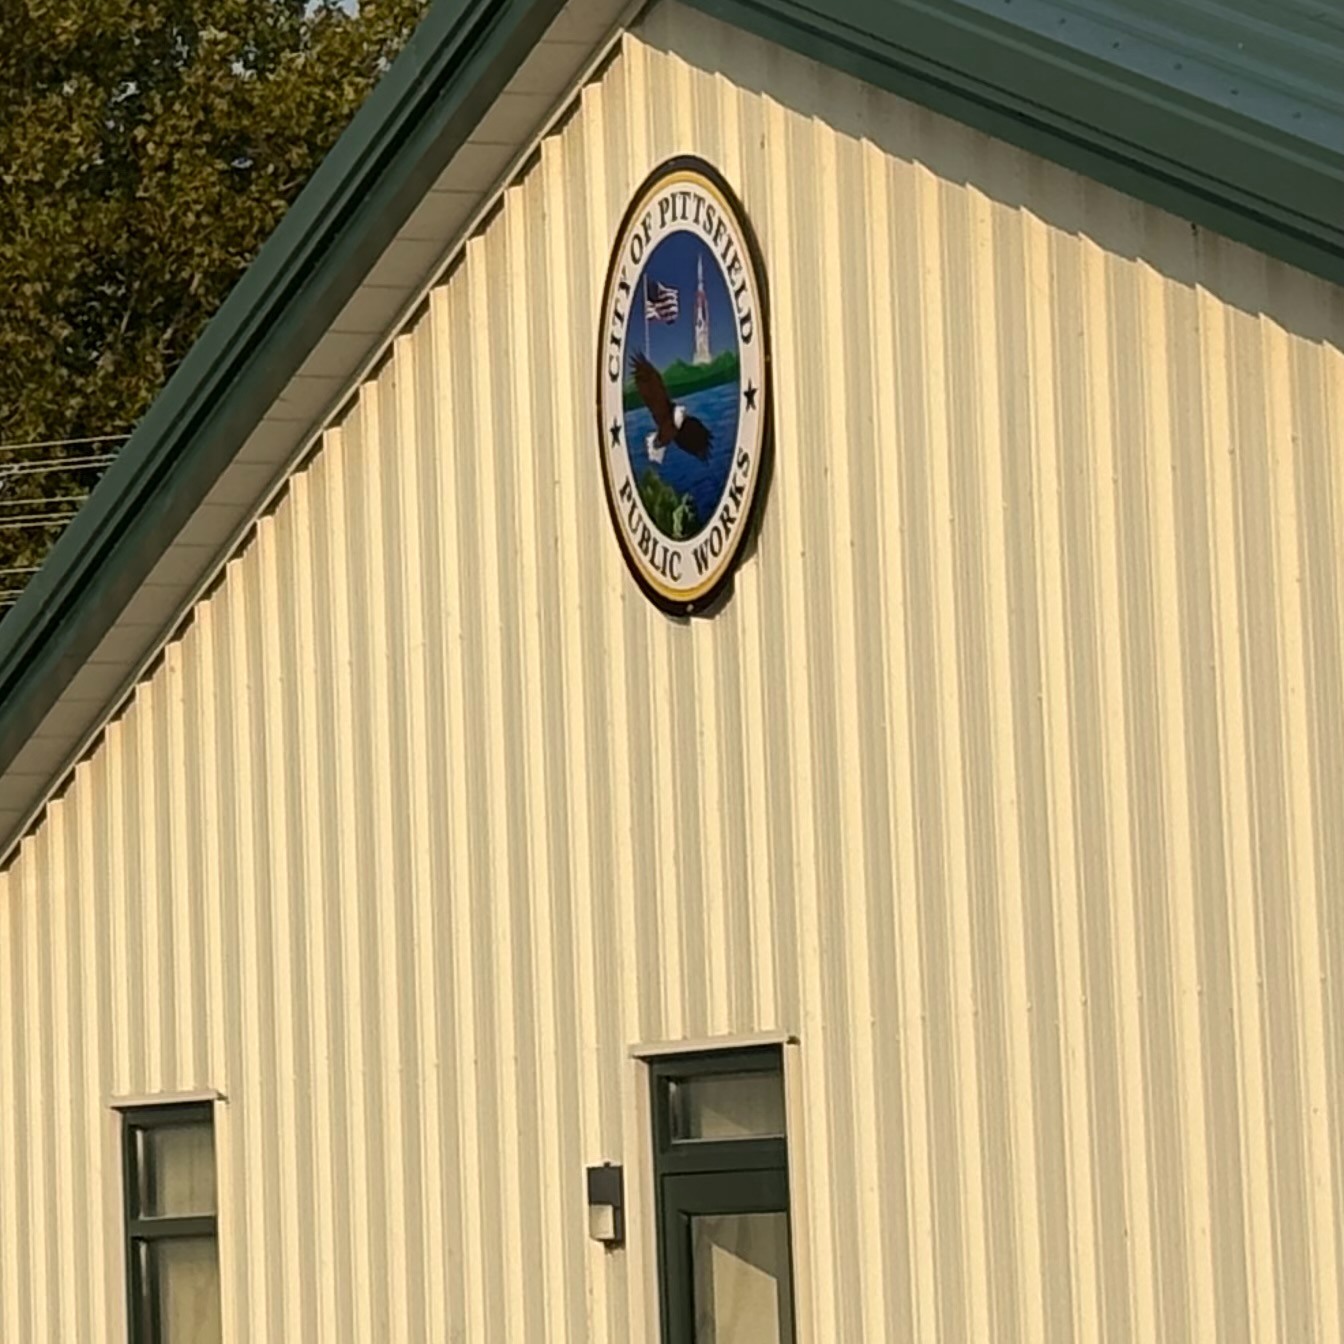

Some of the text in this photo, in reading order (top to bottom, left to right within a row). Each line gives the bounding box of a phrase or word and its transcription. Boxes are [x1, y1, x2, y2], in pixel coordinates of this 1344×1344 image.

[608, 191, 753, 382] CITY OF PITTSFIELD
[619, 447, 751, 582] PUBLIC WORKS
